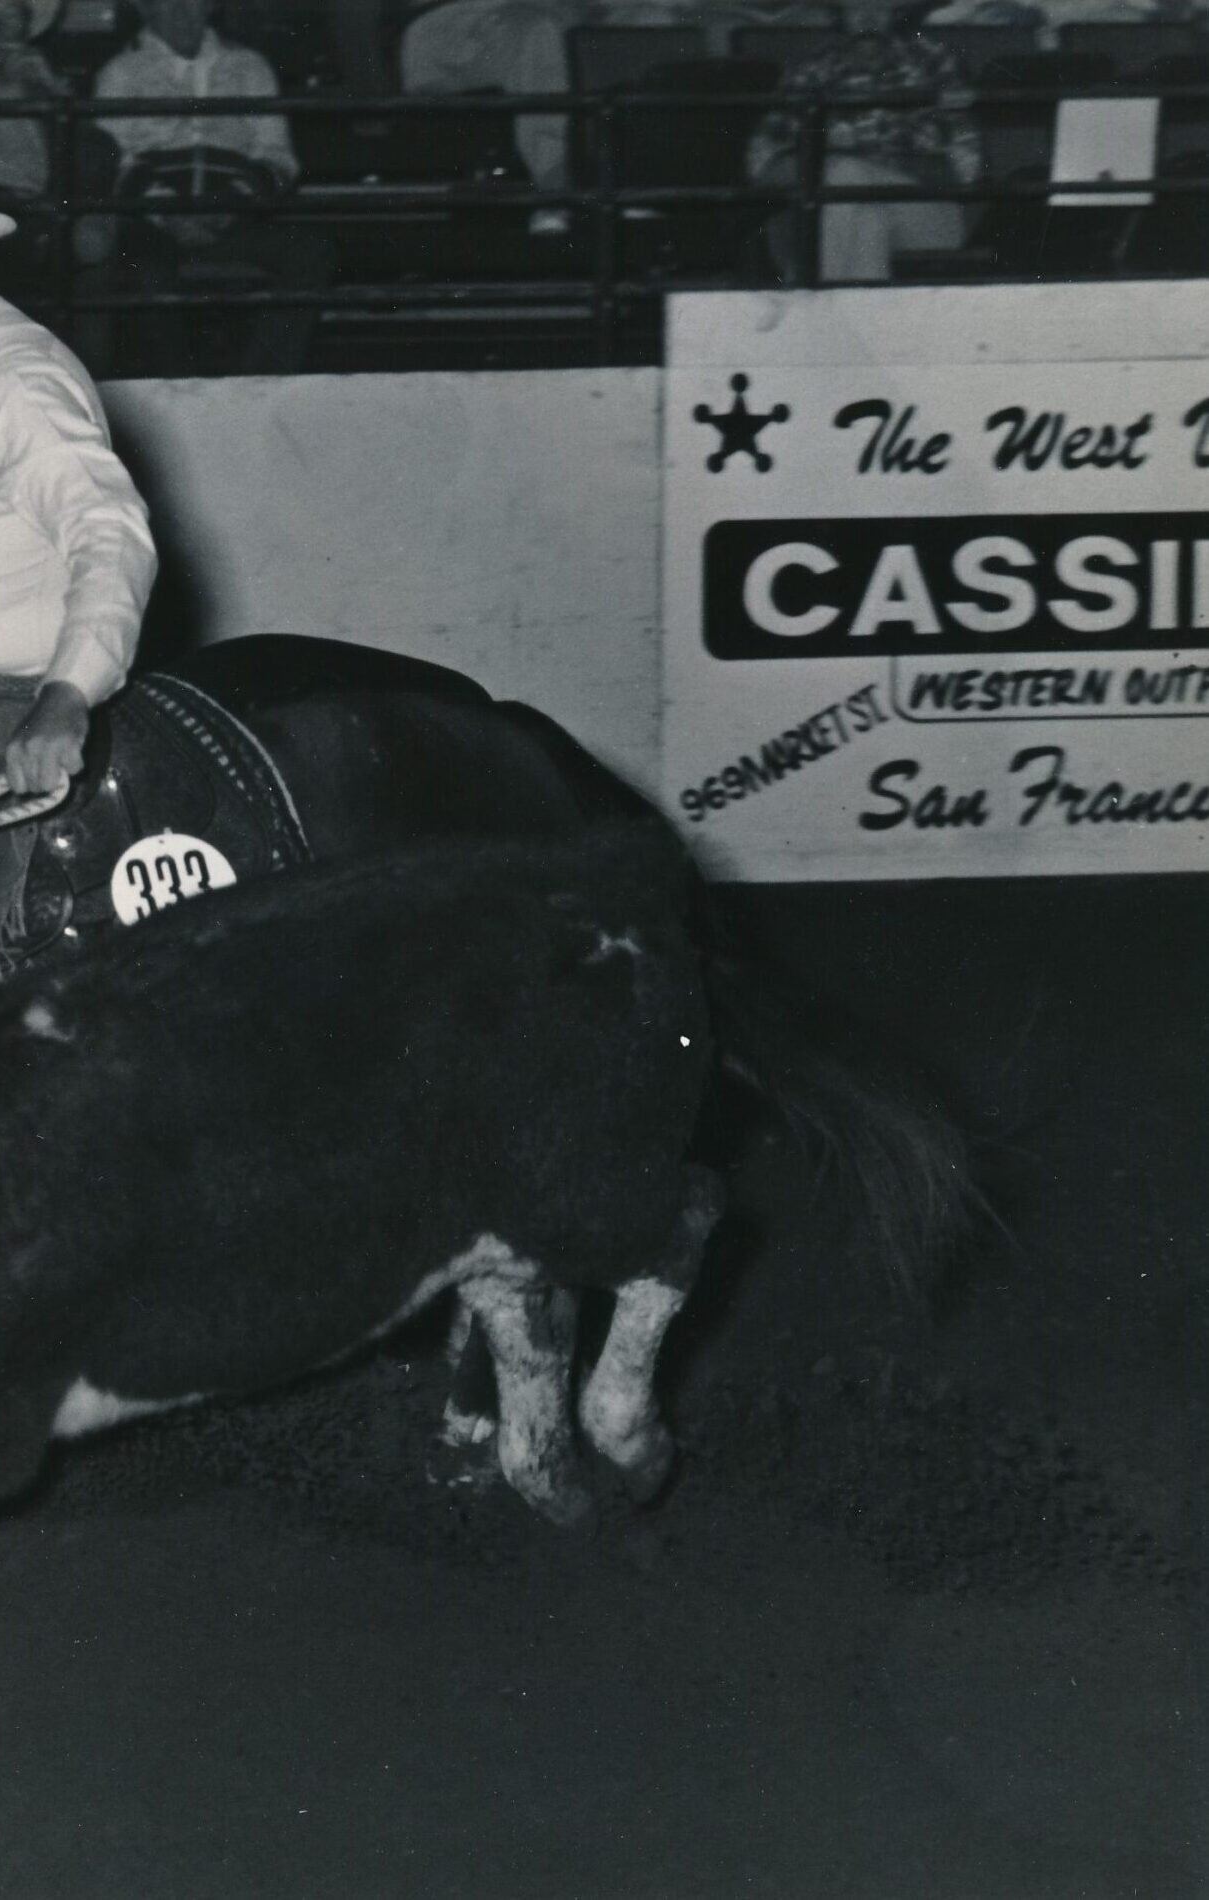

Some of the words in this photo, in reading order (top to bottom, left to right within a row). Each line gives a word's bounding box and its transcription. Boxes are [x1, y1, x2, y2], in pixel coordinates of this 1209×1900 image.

[832, 398, 956, 474] The
[985, 405, 1156, 472] West
[909, 668, 1113, 711] WESTERN
[679, 765, 747, 824] 969
[738, 703, 850, 793] MARKET
[844, 682, 890, 733] ST
[859, 758, 989, 831] San
